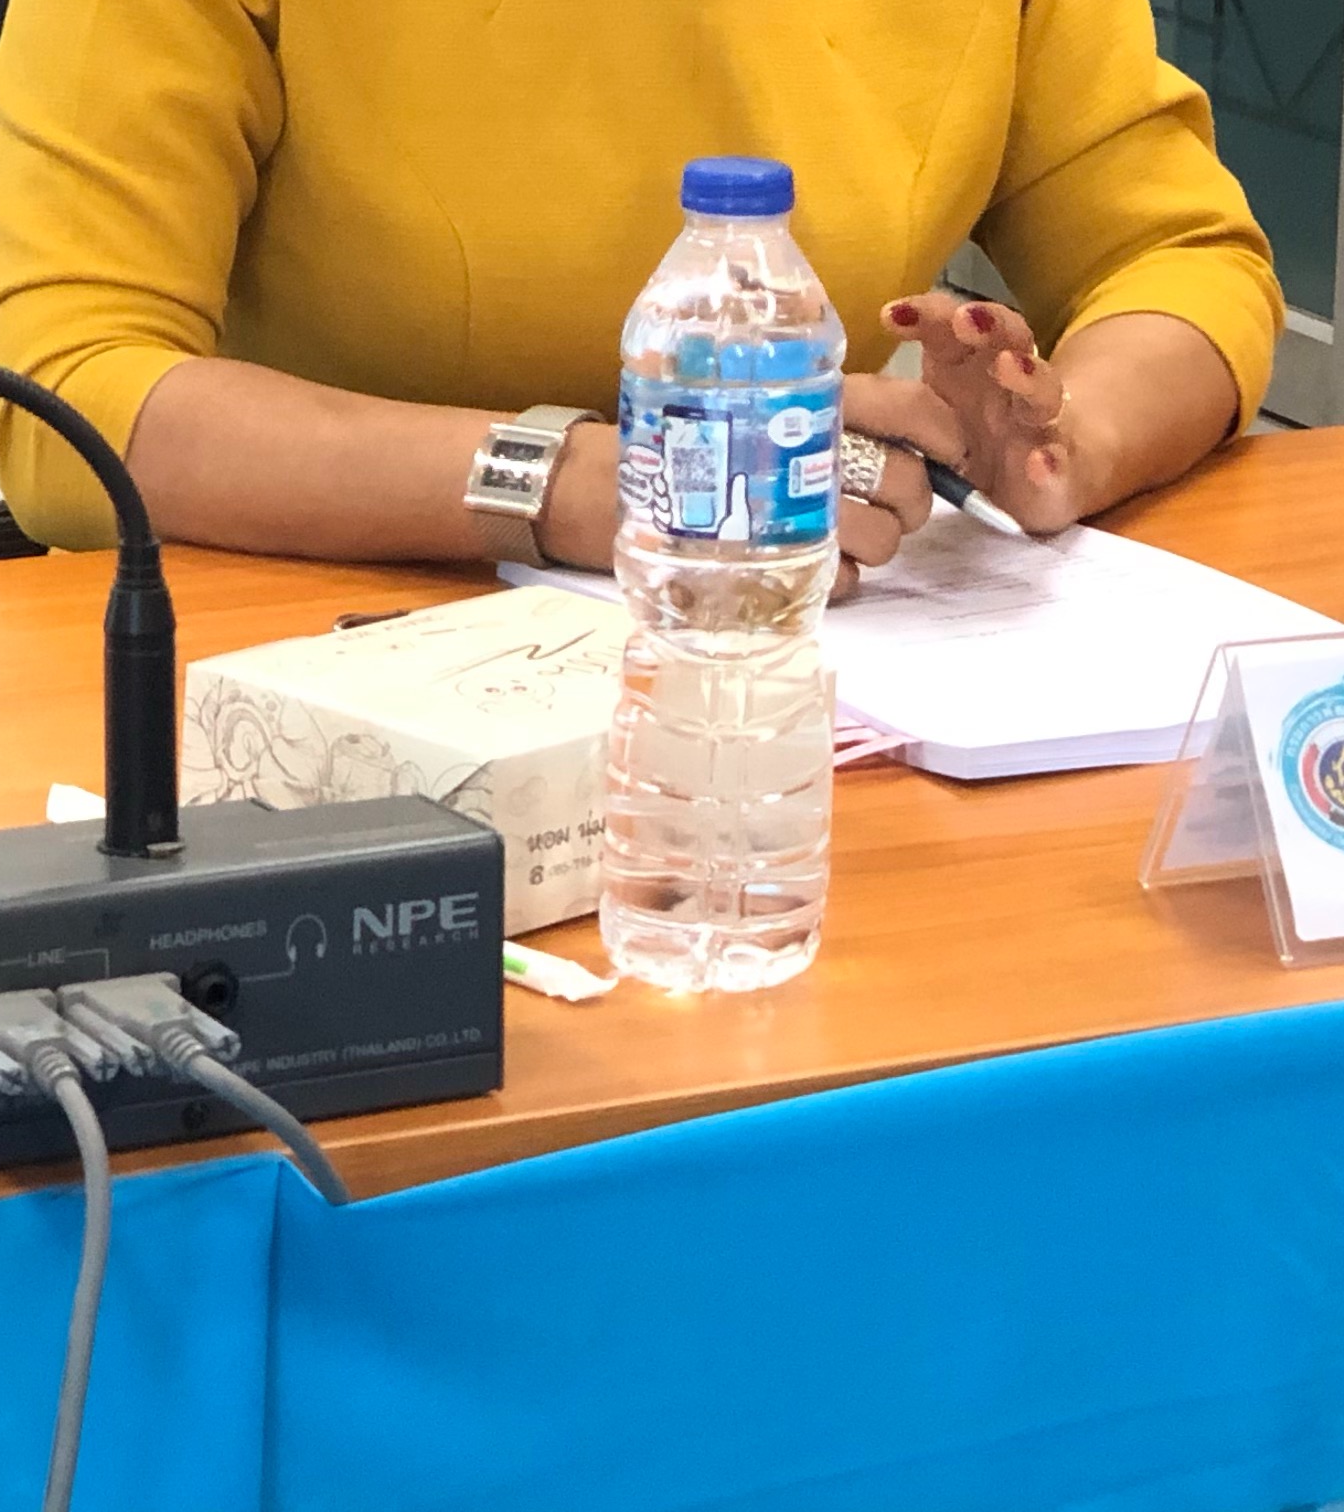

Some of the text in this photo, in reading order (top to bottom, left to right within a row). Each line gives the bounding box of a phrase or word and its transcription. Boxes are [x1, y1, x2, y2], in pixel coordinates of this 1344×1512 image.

[352, 891, 480, 942] NPE
[149, 919, 268, 951] HEADPHONES
[352, 928, 480, 955] RESEARCH
[27, 946, 66, 968] LINE
